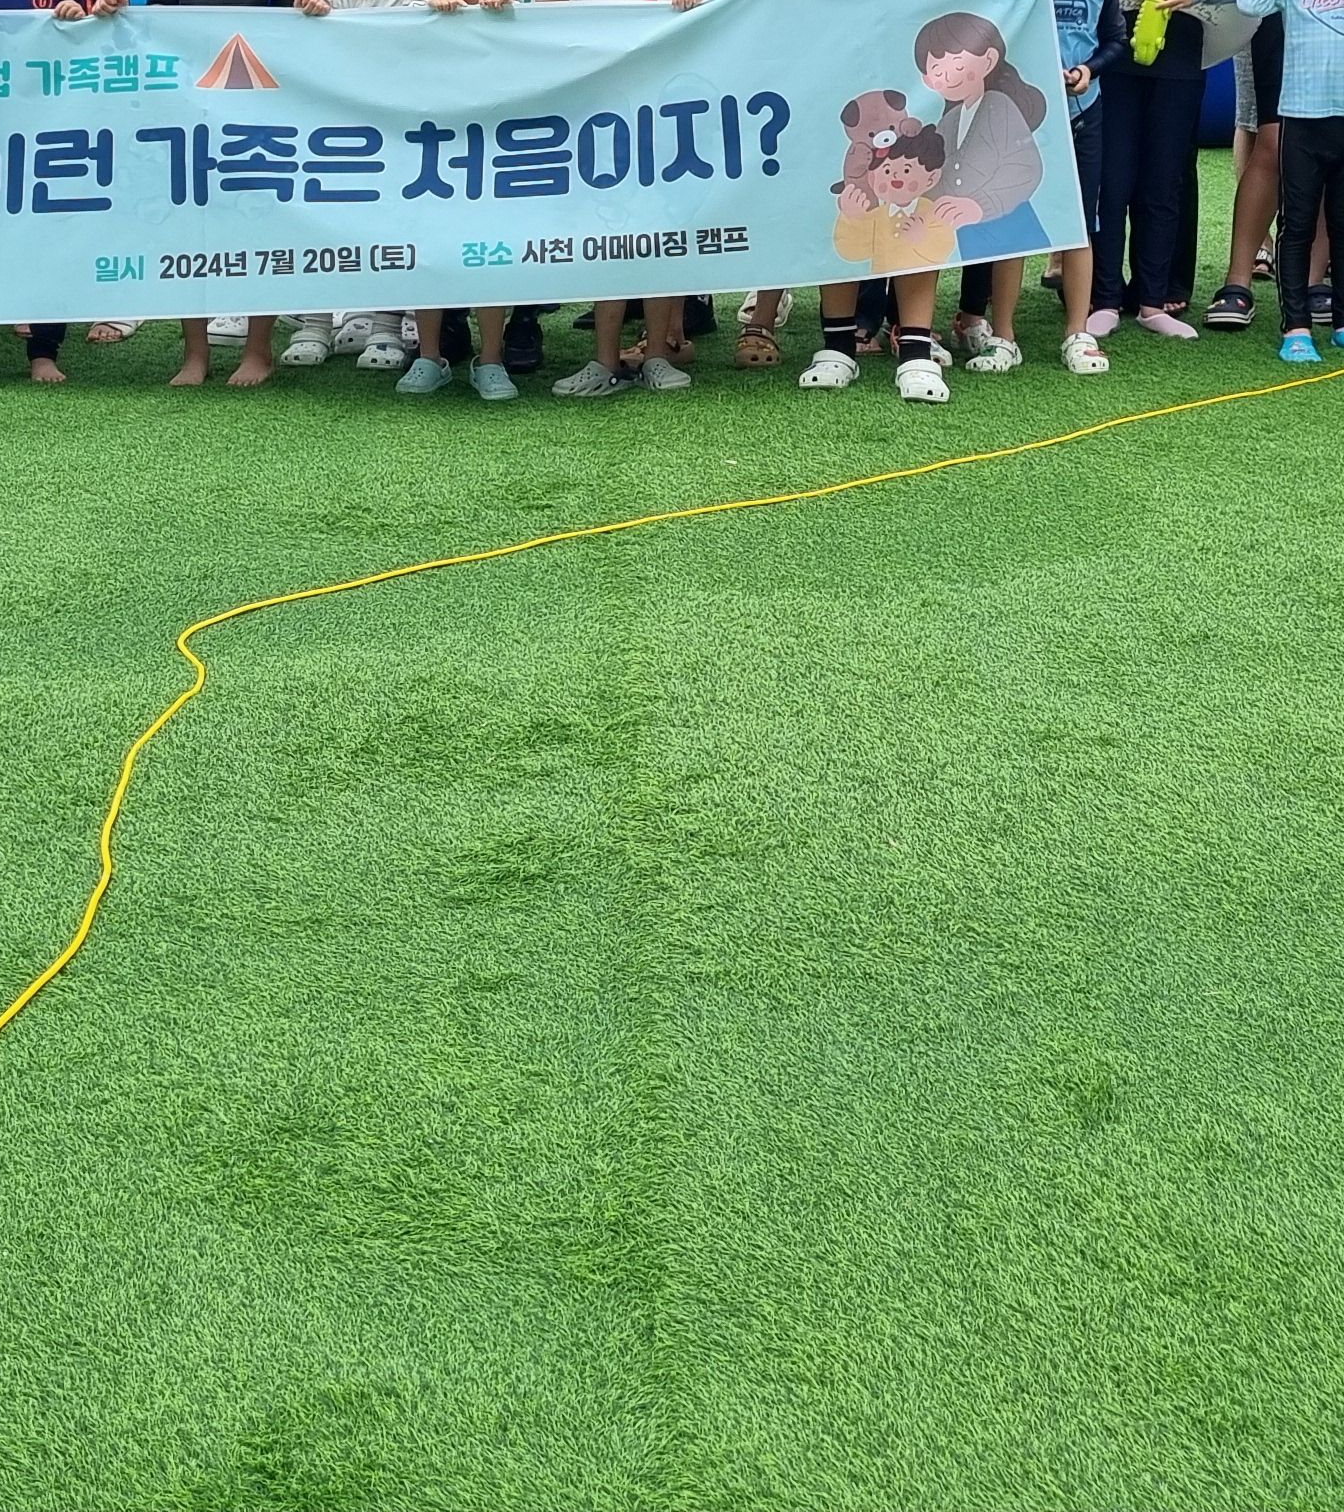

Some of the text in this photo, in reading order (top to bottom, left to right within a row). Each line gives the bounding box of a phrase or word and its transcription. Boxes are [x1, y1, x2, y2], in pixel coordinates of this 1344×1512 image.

[25, 54, 181, 97] 가족캠프
[135, 123, 386, 207] 가족은
[401, 91, 792, 202] 처음이지?
[95, 244, 416, 282] 일시 2024년 7월 20일 (토)
[462, 226, 750, 267] 장소 사천 어메이징 캠프
